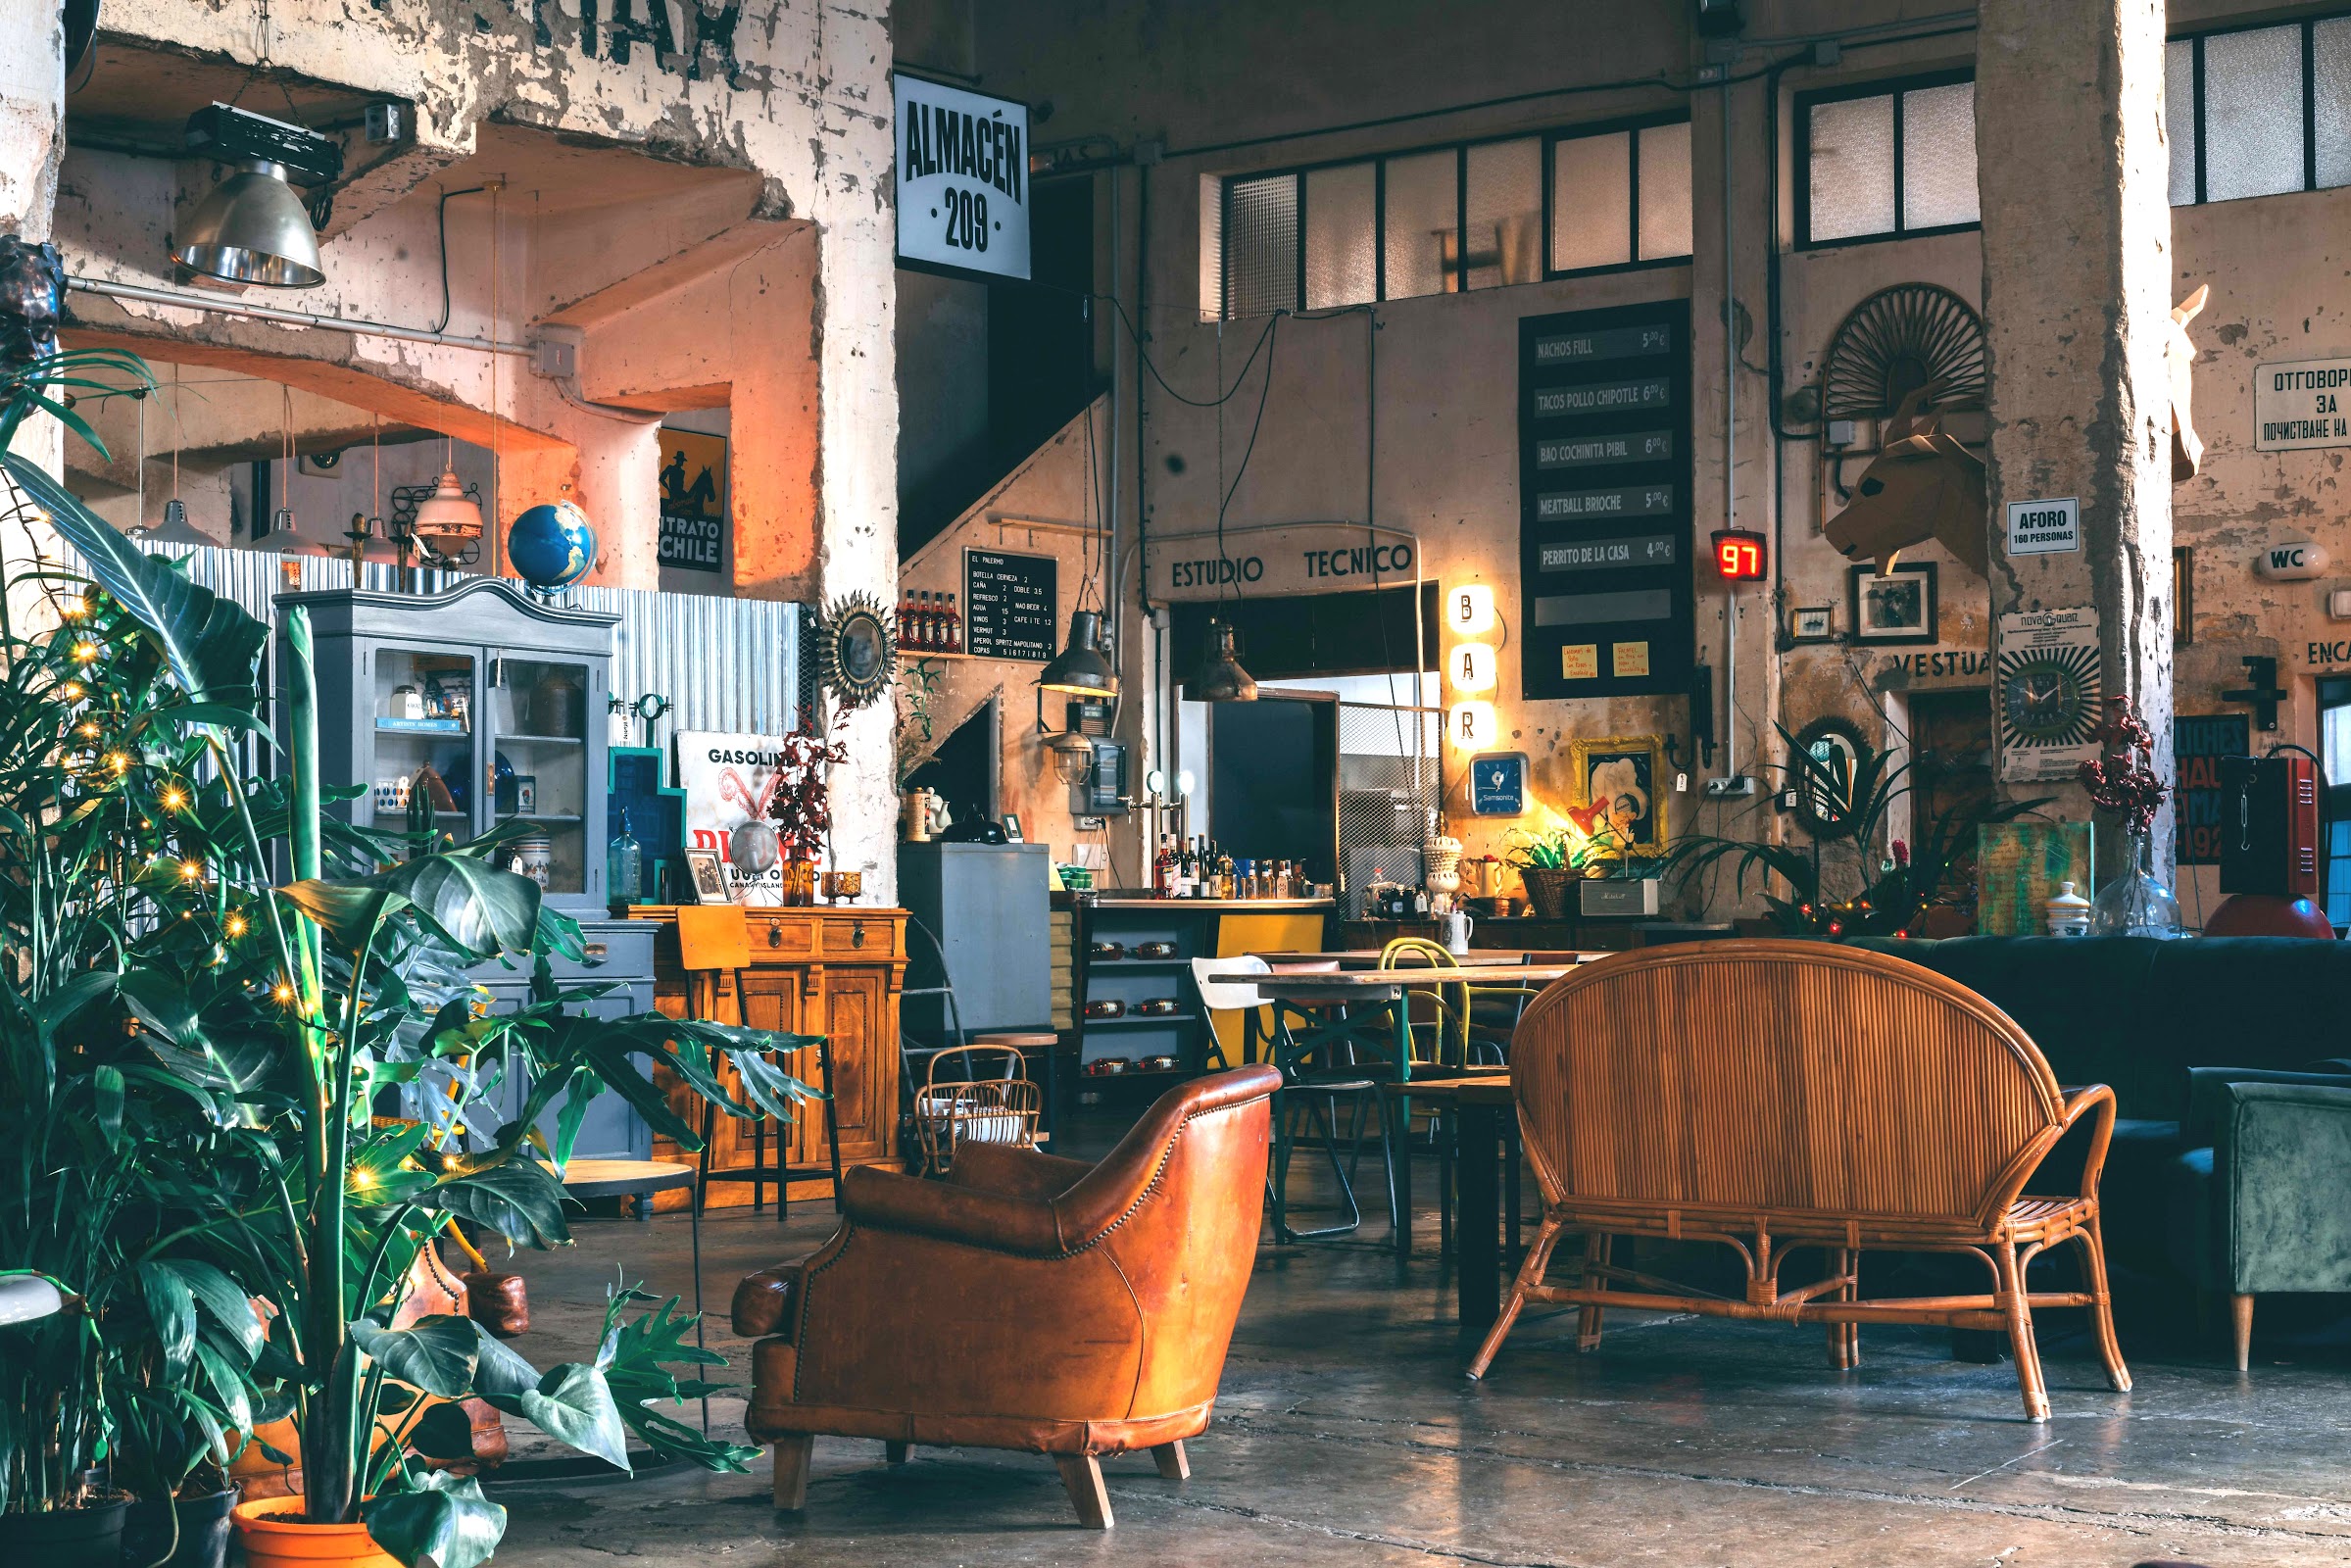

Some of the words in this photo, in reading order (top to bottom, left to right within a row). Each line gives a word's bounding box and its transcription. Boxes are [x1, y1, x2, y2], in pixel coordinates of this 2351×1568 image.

[906, 100, 1021, 205] ALMACÉN
[945, 186, 988, 253] 209
[1538, 341, 1571, 358] NACHOS
[1573, 339, 1592, 356] FULL
[2275, 368, 2351, 391] ОТГОВОР
[1538, 394, 1565, 411] TACOS
[1567, 391, 1594, 408] POLLO
[1596, 386, 1639, 406] CHIPOTLE
[2317, 394, 2337, 414] ЗА
[2264, 418, 2328, 441] ПОЧИСТВАНЕ
[2333, 417, 2347, 437] НА
[1541, 446, 1557, 463] BAO
[1559, 442, 1604, 461] COCHINITA
[1606, 441, 1628, 457] PIBIL
[1540, 498, 1583, 514] MEATBALL
[1585, 495, 1622, 513] BRIOCHE
[2019, 510, 2067, 529] AFORO
[2014, 534, 2028, 544] 160
[2030, 530, 2074, 543] PERSONAS
[659, 535, 718, 564] CHILE
[1543, 549, 1579, 565] PERRITO
[1581, 547, 1592, 563] DE
[1594, 546, 1605, 562] LA
[1607, 544, 1630, 561] CASA
[1723, 545, 1756, 573] 97
[2271, 549, 2304, 568] WC
[982, 556, 1004, 565] PALERMO
[1172, 556, 1264, 587] ESTUDIO
[1303, 544, 1413, 578] TECNICO
[973, 570, 994, 579] BOTELLA
[997, 573, 1018, 582] CERVEZA
[973, 580, 987, 589] CAÑA
[1013, 585, 1030, 594] DOBLE
[973, 593, 999, 602] REFRESCO
[1026, 603, 1040, 612] BEER
[973, 646, 991, 655] COPAS
[996, 638, 1012, 647] SPRITZ
[1013, 640, 1043, 650] NAPOLITANO
[1483, 794, 1514, 803] Samsonite
